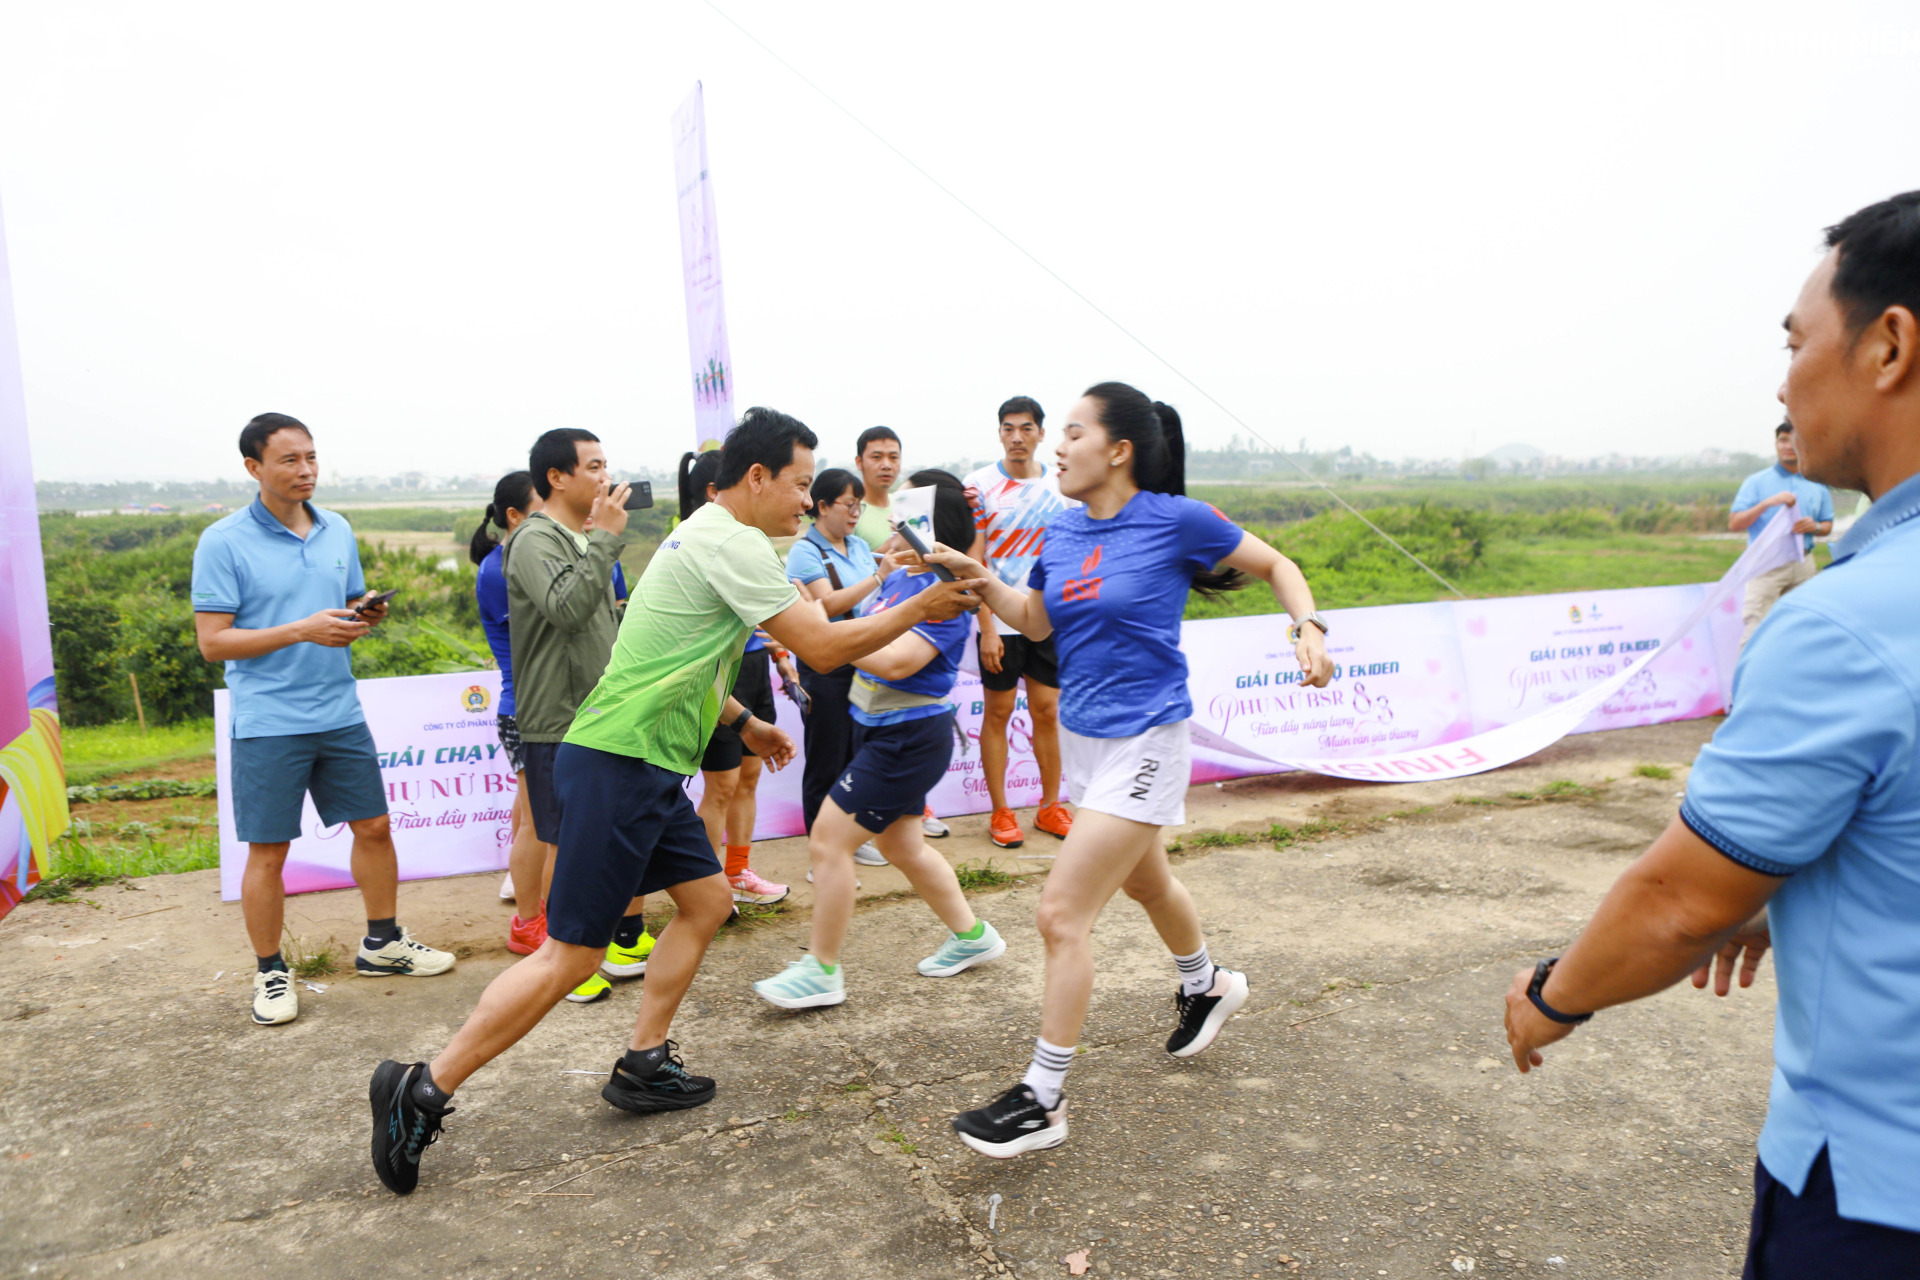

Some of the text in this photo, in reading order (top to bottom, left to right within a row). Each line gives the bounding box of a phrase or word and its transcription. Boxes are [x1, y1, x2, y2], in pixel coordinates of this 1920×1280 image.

[1062, 577, 1103, 602] BSR
[1275, 670, 1304, 686] CHẠ
[1349, 661, 1399, 678] EKIDEN
[971, 701, 984, 715] B
[1307, 690, 1343, 708] BSR
[424, 723, 444, 732] CÔNG
[376, 743, 502, 769] GIẢI CHẠY
[384, 771, 518, 805] HỤ NỮ BS
[1129, 758, 1160, 801] RUN
